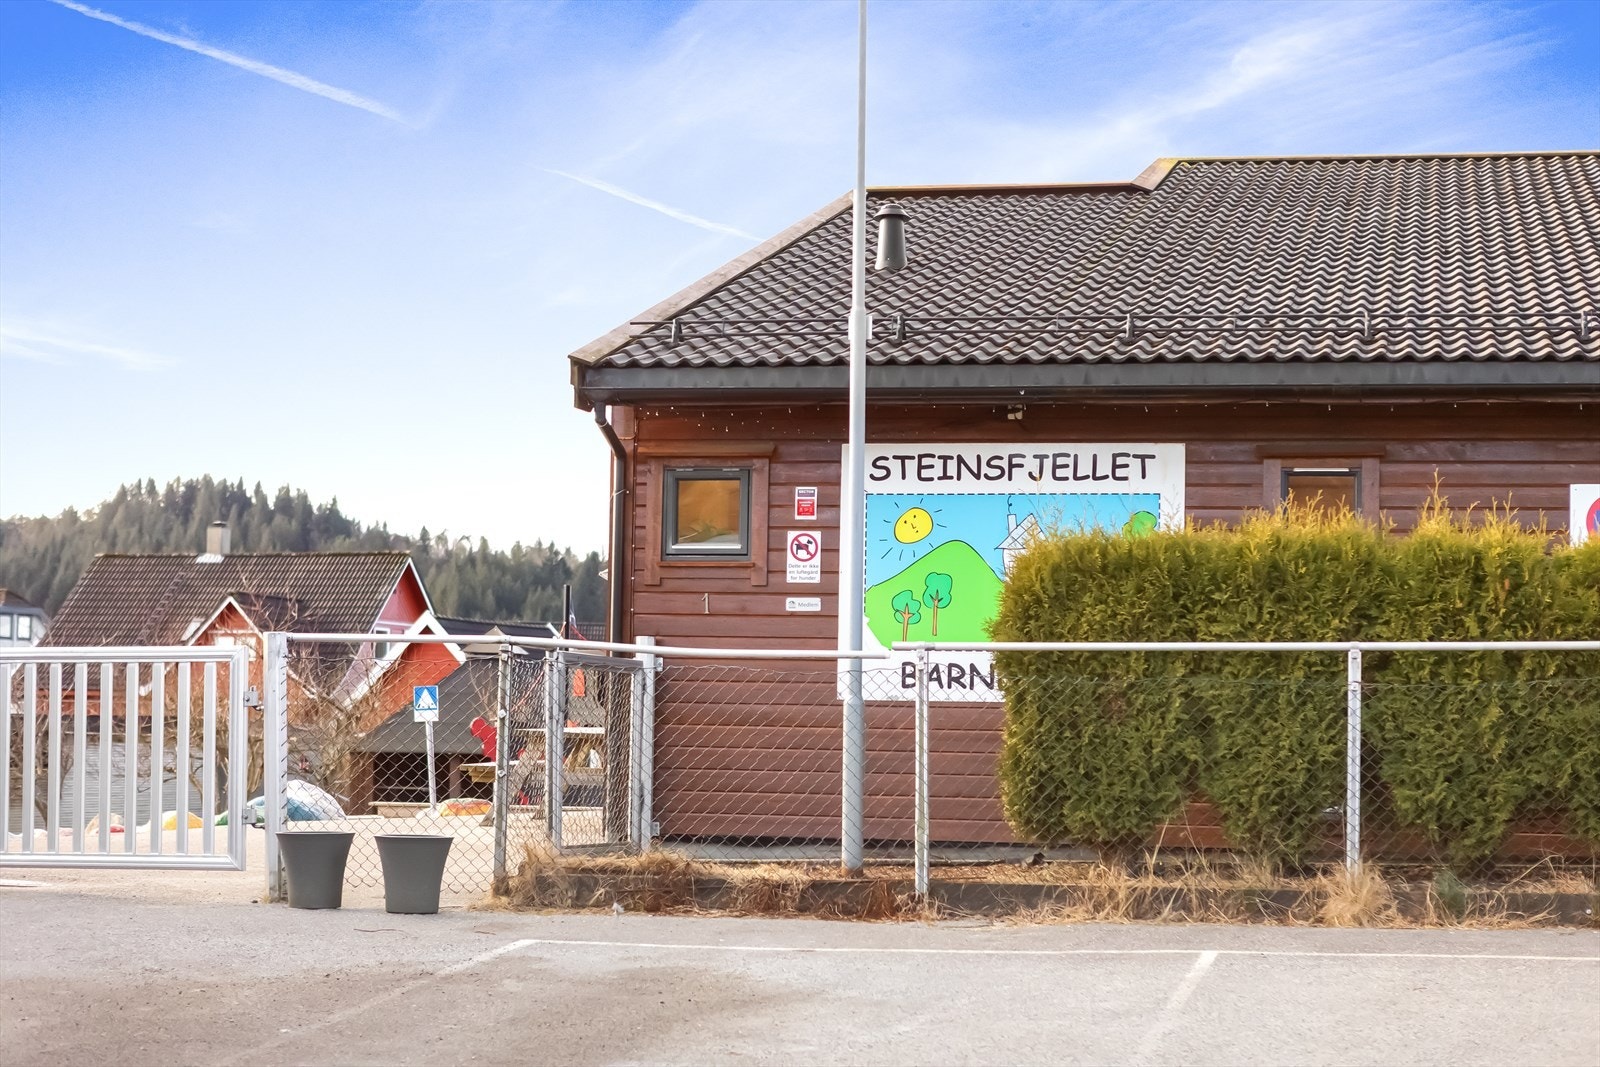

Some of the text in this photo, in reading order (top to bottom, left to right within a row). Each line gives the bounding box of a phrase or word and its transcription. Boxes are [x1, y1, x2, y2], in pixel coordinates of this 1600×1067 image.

[869, 452, 1156, 482] STEINSFJELLET
[701, 592, 710, 614] 1
[901, 661, 995, 691] BARN
